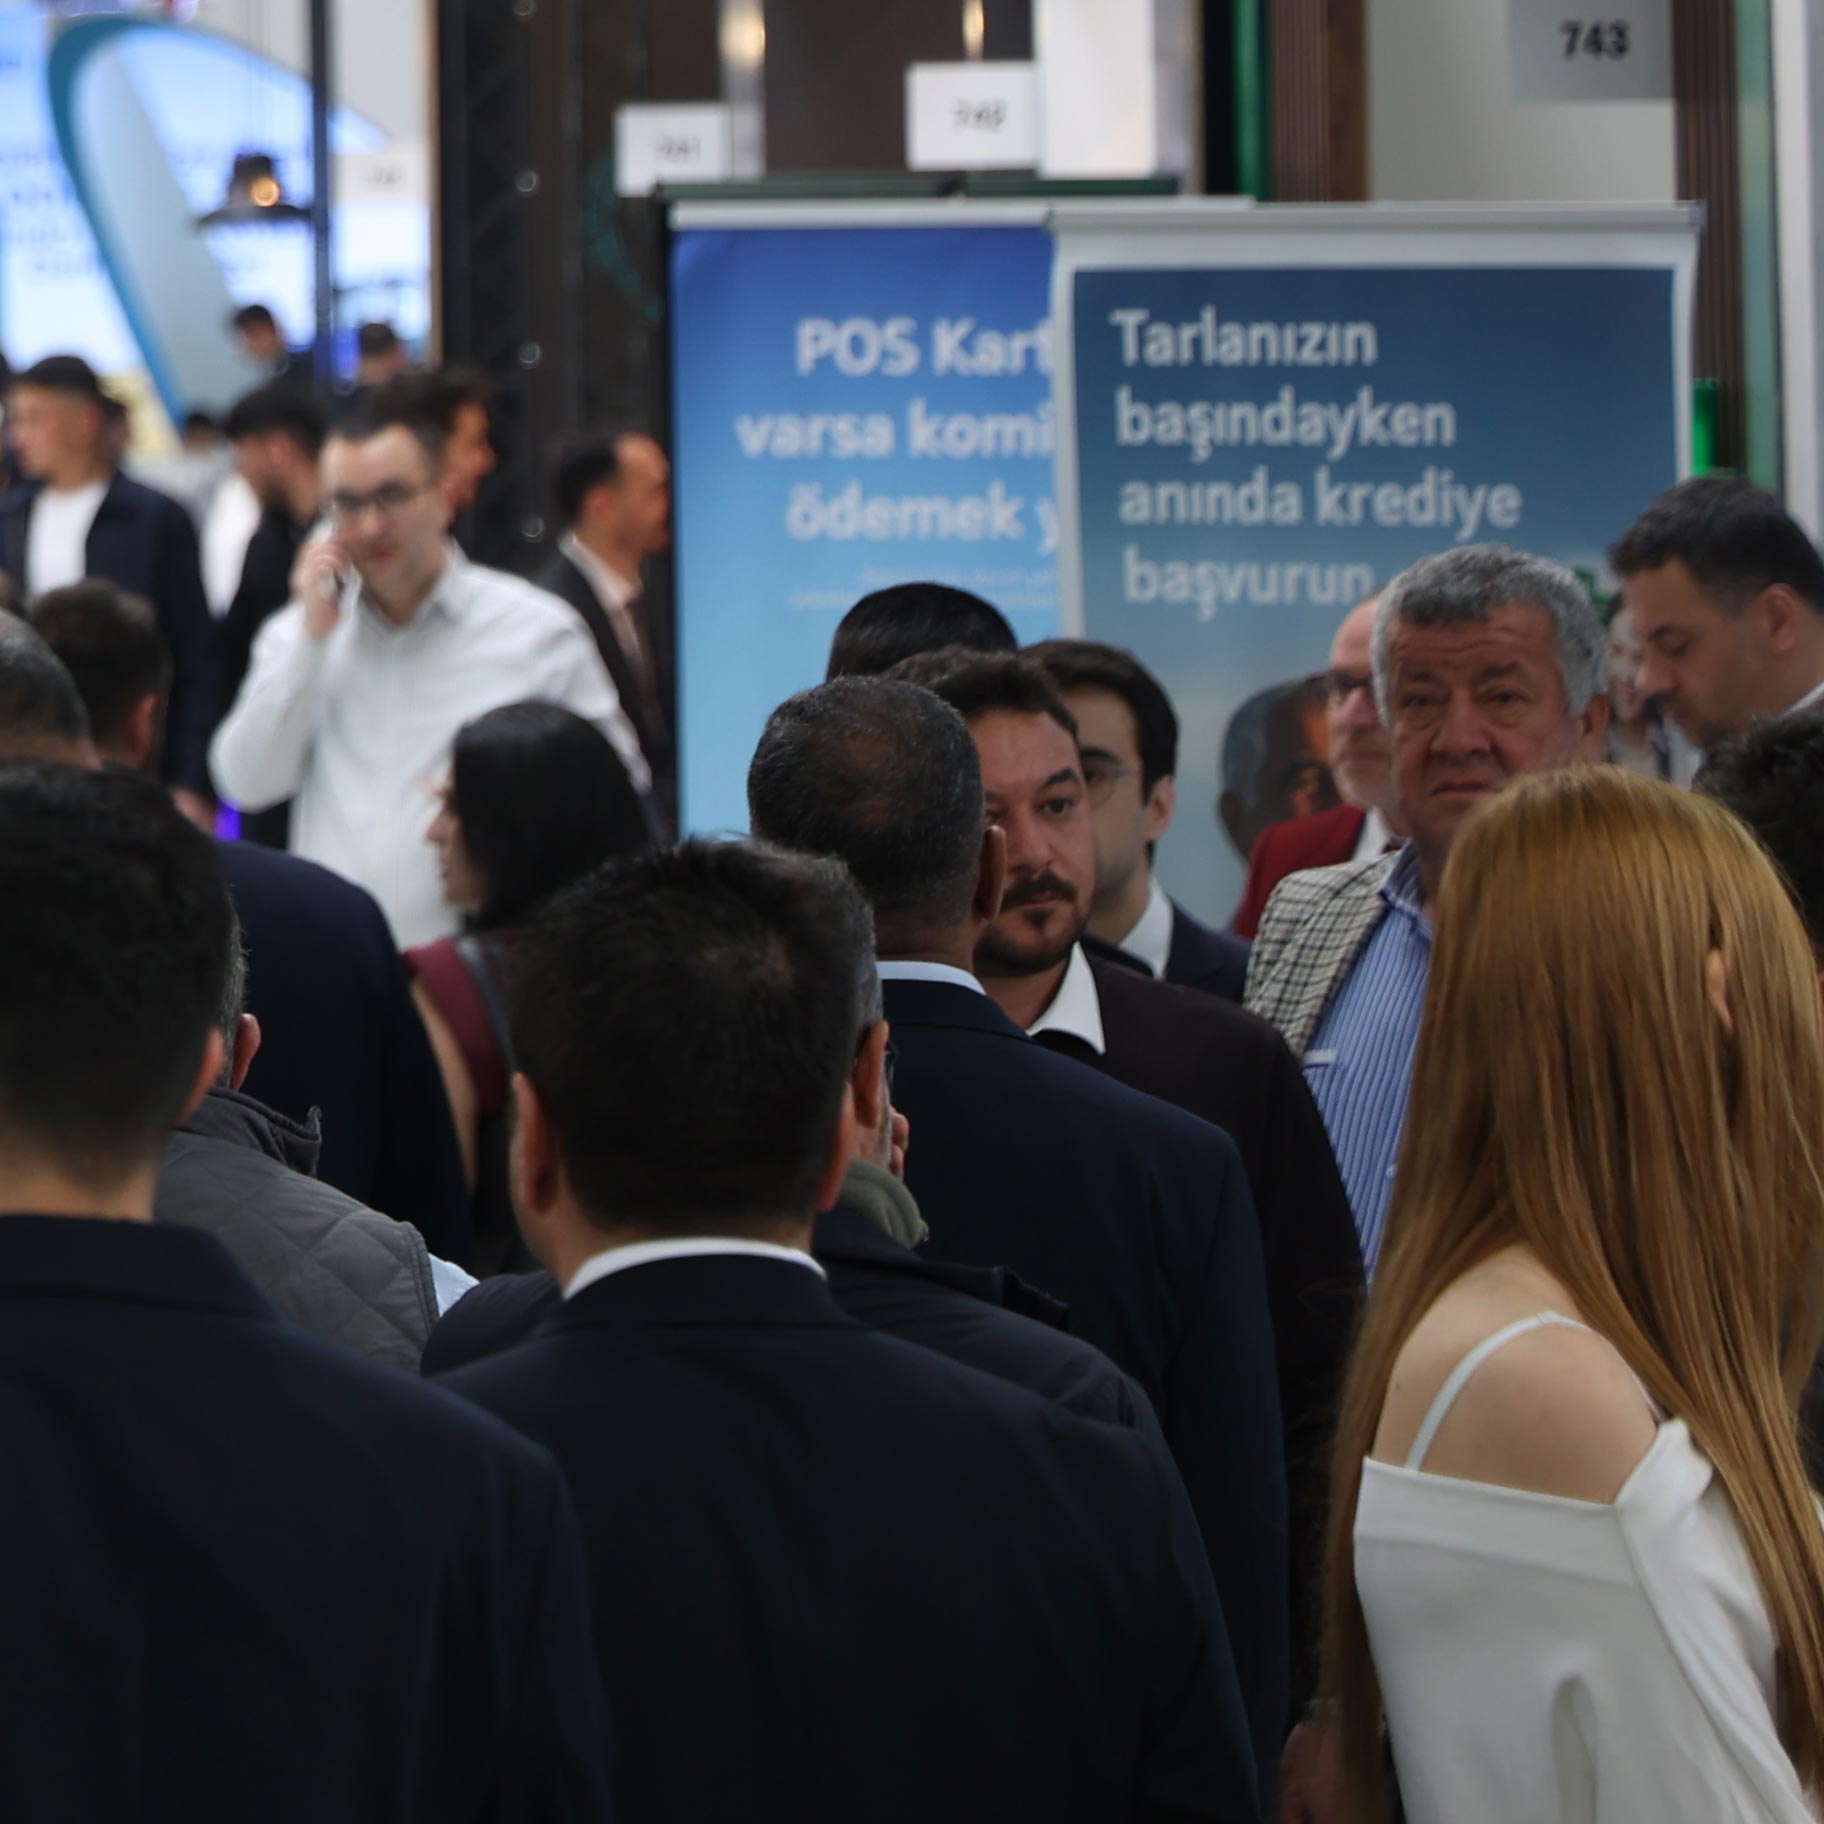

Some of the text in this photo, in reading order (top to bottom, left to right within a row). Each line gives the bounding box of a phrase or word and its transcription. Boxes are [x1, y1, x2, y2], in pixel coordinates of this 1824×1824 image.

[1559, 19, 1632, 61] 743
[796, 315, 921, 377] POS
[1109, 305, 1379, 366] Tarlanızın
[735, 412, 896, 459] varsa
[1115, 385, 1457, 463] başındayken
[786, 478, 1026, 542] ödemek
[1118, 465, 1523, 541] anında krediye
